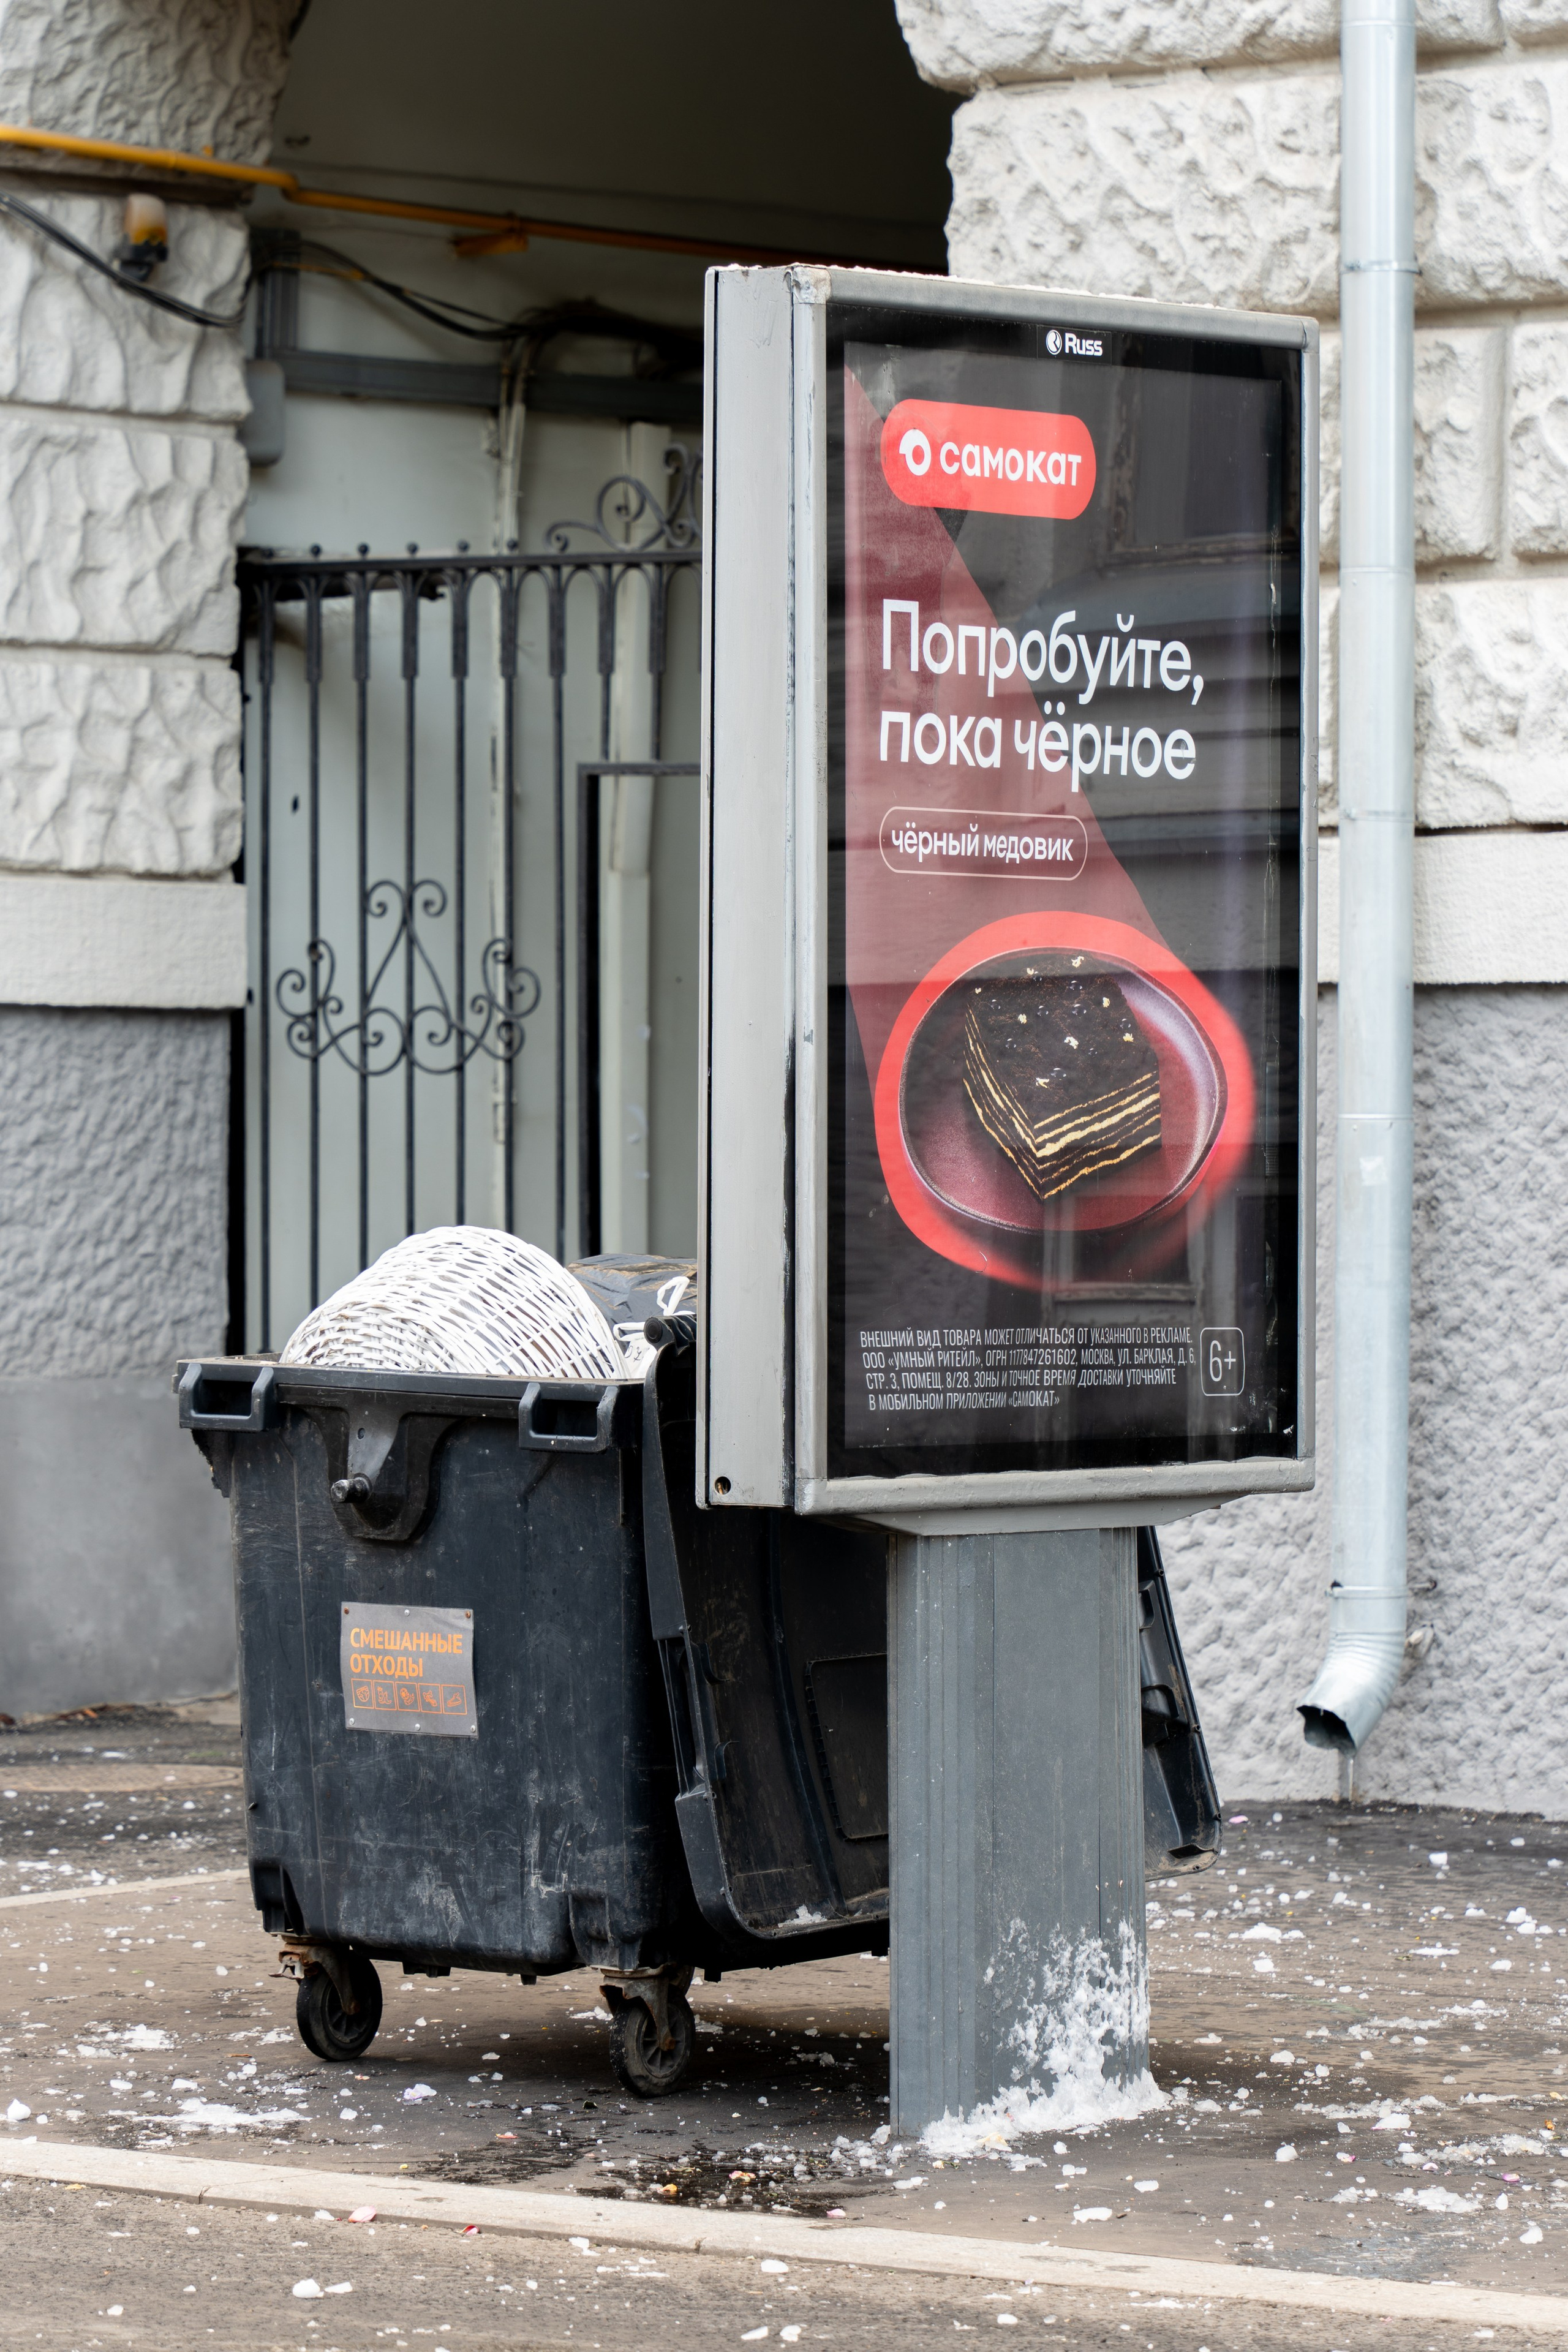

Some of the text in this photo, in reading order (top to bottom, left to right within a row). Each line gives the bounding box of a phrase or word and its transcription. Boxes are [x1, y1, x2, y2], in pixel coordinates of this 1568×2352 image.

[1065, 333, 1102, 356] Russ
[882, 598, 1204, 706] Попробуйте,
[880, 701, 1196, 793] пока чёрное
[891, 821, 1074, 864] чёрный медовик
[861, 1327, 1193, 1348] ВНЕШНИЙ ВИД ТОВАРА МОЖЕТ ОТЛИЧАТЬСЯ ОТ УКАЗАННОГО В РЕКЛАМЕ.
[862, 1347, 1196, 1370] ООО «УМНЫЙ РИТЕЙЛ», ОГРН 1177847261602, МОСКВА, УЛ. БАРКЛАЯ, Д. 6,
[1210, 1340, 1236, 1381] 6+
[866, 1365, 1176, 1390] СТР. 3, ПОМЕЩ. 8/28. ЗОНЫ И ТОЧНОЕ ВРЕМЯ ДОСТАВКИ УТОЧНЯЙТЕ
[869, 1390, 1060, 1410] В МОБИЛЬНОМ ПРИЛОЖЕНИИ «САМОКАТ»
[350, 1627, 462, 1654] СМЕШАННЫЕ
[350, 1654, 423, 1679] ОТХОДЫ
